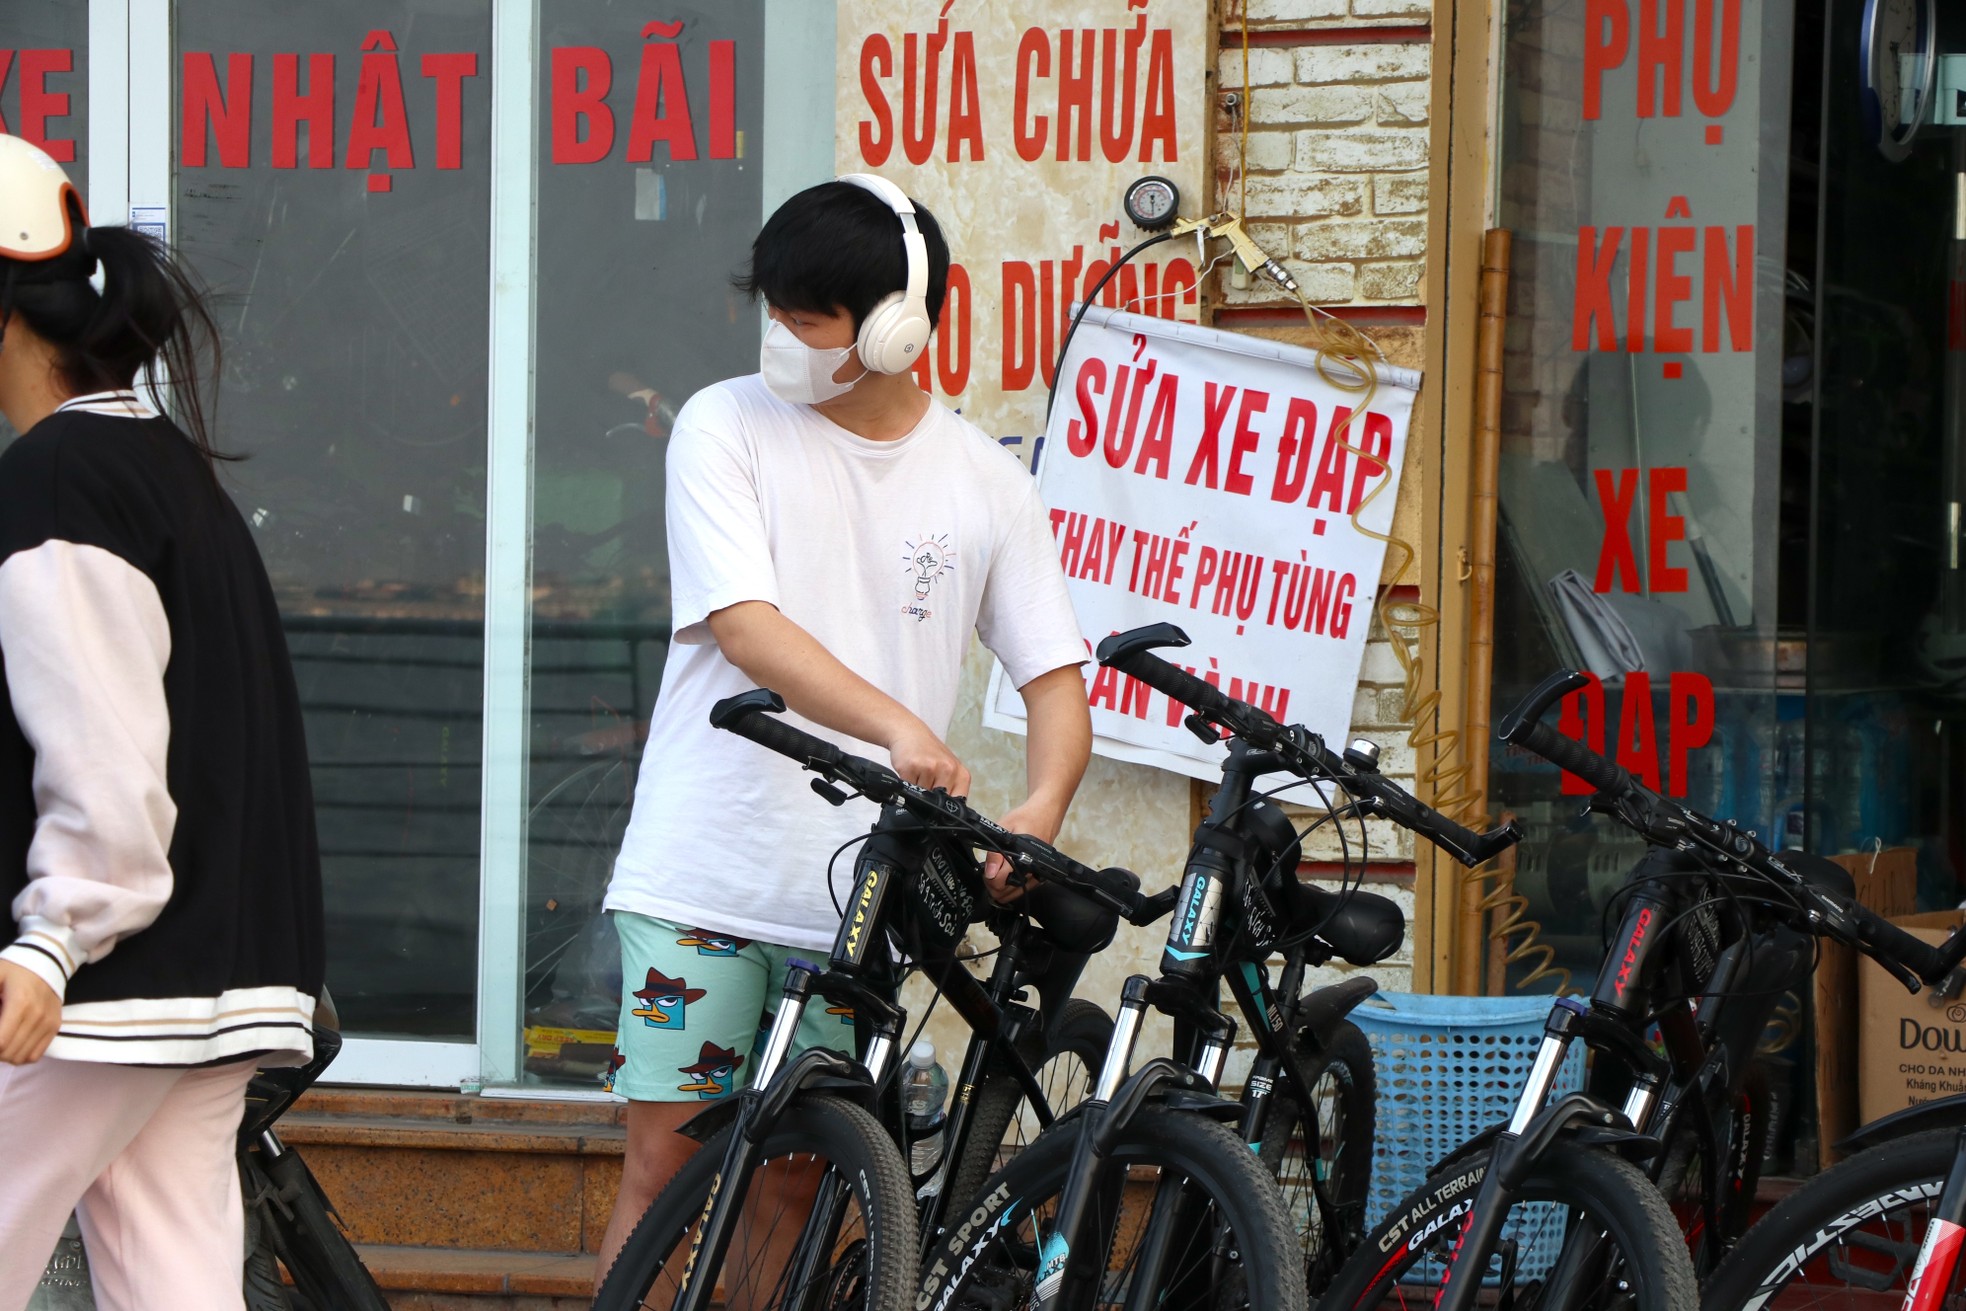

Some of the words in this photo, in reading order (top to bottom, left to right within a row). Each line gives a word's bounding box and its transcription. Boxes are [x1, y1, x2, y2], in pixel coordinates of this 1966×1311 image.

[181, 30, 477, 192] NHẬT
[550, 20, 737, 165] BÃI
[1583, 0, 1740, 145] PHỤ
[1572, 196, 1755, 379] KIỆN
[1066, 333, 1179, 480] SỬA
[1184, 380, 1270, 497] XE
[1271, 397, 1393, 537] ĐẠP
[1128, 520, 1199, 607] THẾ
[1191, 545, 1264, 635] PHỤ
[1265, 549, 1357, 640] TÙNG
[1593, 467, 1689, 594] XE
[847, 870, 878, 957] GALAXY
[1182, 876, 1206, 946] GALAXY
[1614, 908, 1652, 998] GALAXY
[1250, 1080, 1273, 1091] SIZE
[1899, 1063, 1926, 1075] CHO
[1928, 1065, 1945, 1076] DA
[1906, 1078, 1937, 1093] Kháng
[915, 1257, 949, 1311] CST
[948, 1181, 1011, 1256] SPORT
[1378, 1215, 1409, 1253] CST
[1411, 1197, 1437, 1224] ALL
